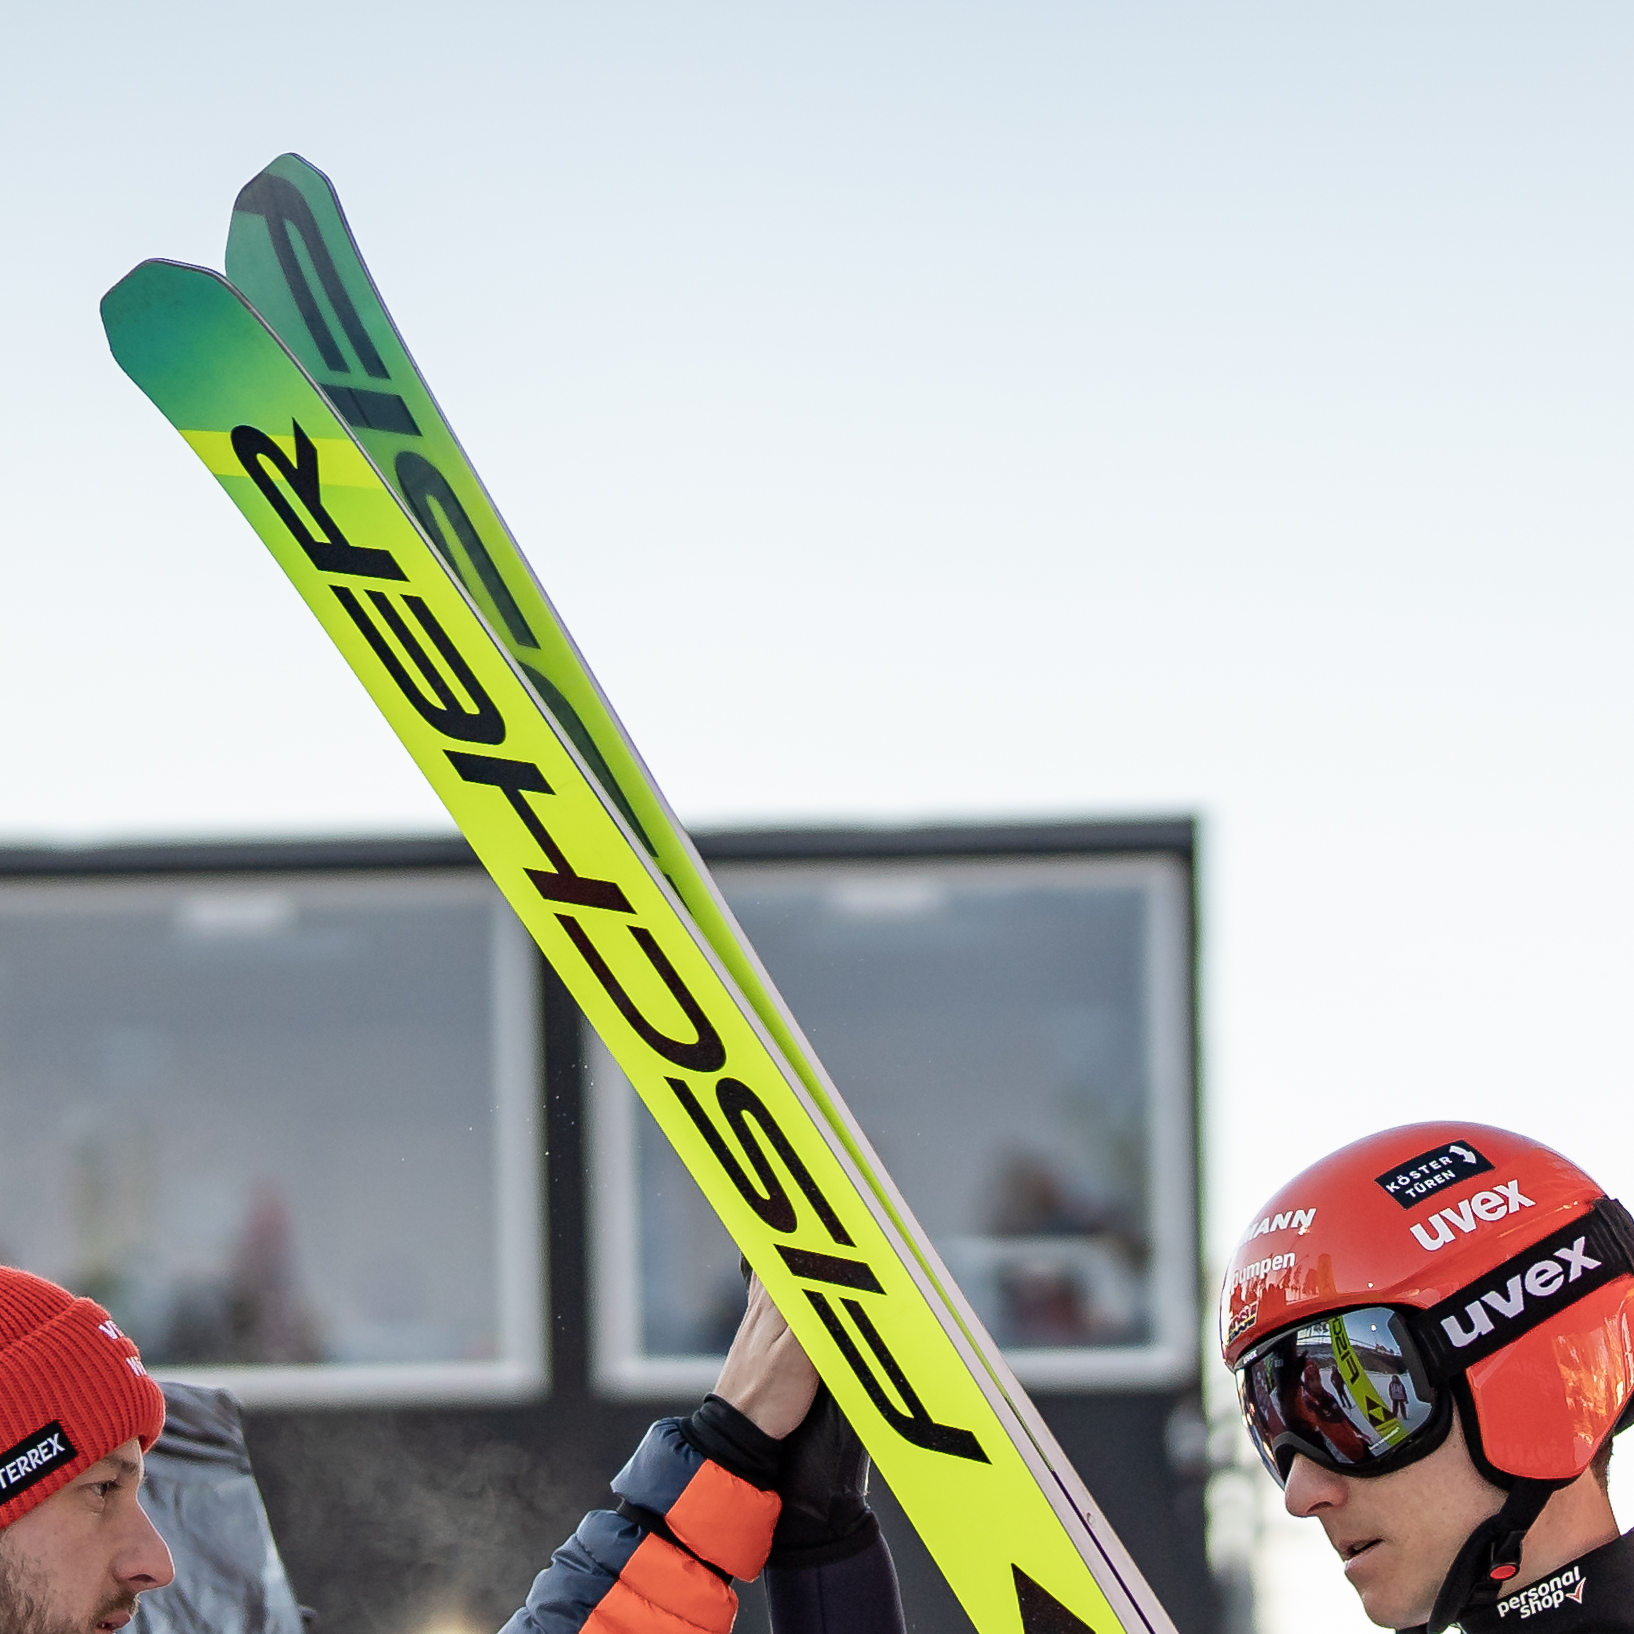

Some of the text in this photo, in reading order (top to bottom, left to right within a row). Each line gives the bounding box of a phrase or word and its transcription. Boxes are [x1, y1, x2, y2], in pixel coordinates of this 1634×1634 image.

[230, 416, 992, 1465] FISCHER
[1385, 1154, 1453, 1194] KÖSTER
[1405, 1169, 1456, 1199] TÜREN
[1410, 1179, 1537, 1252] uvex
[1441, 1235, 1603, 1349] uvex
[1496, 1565, 1581, 1619] personal
[1519, 1589, 1565, 1620] shop
